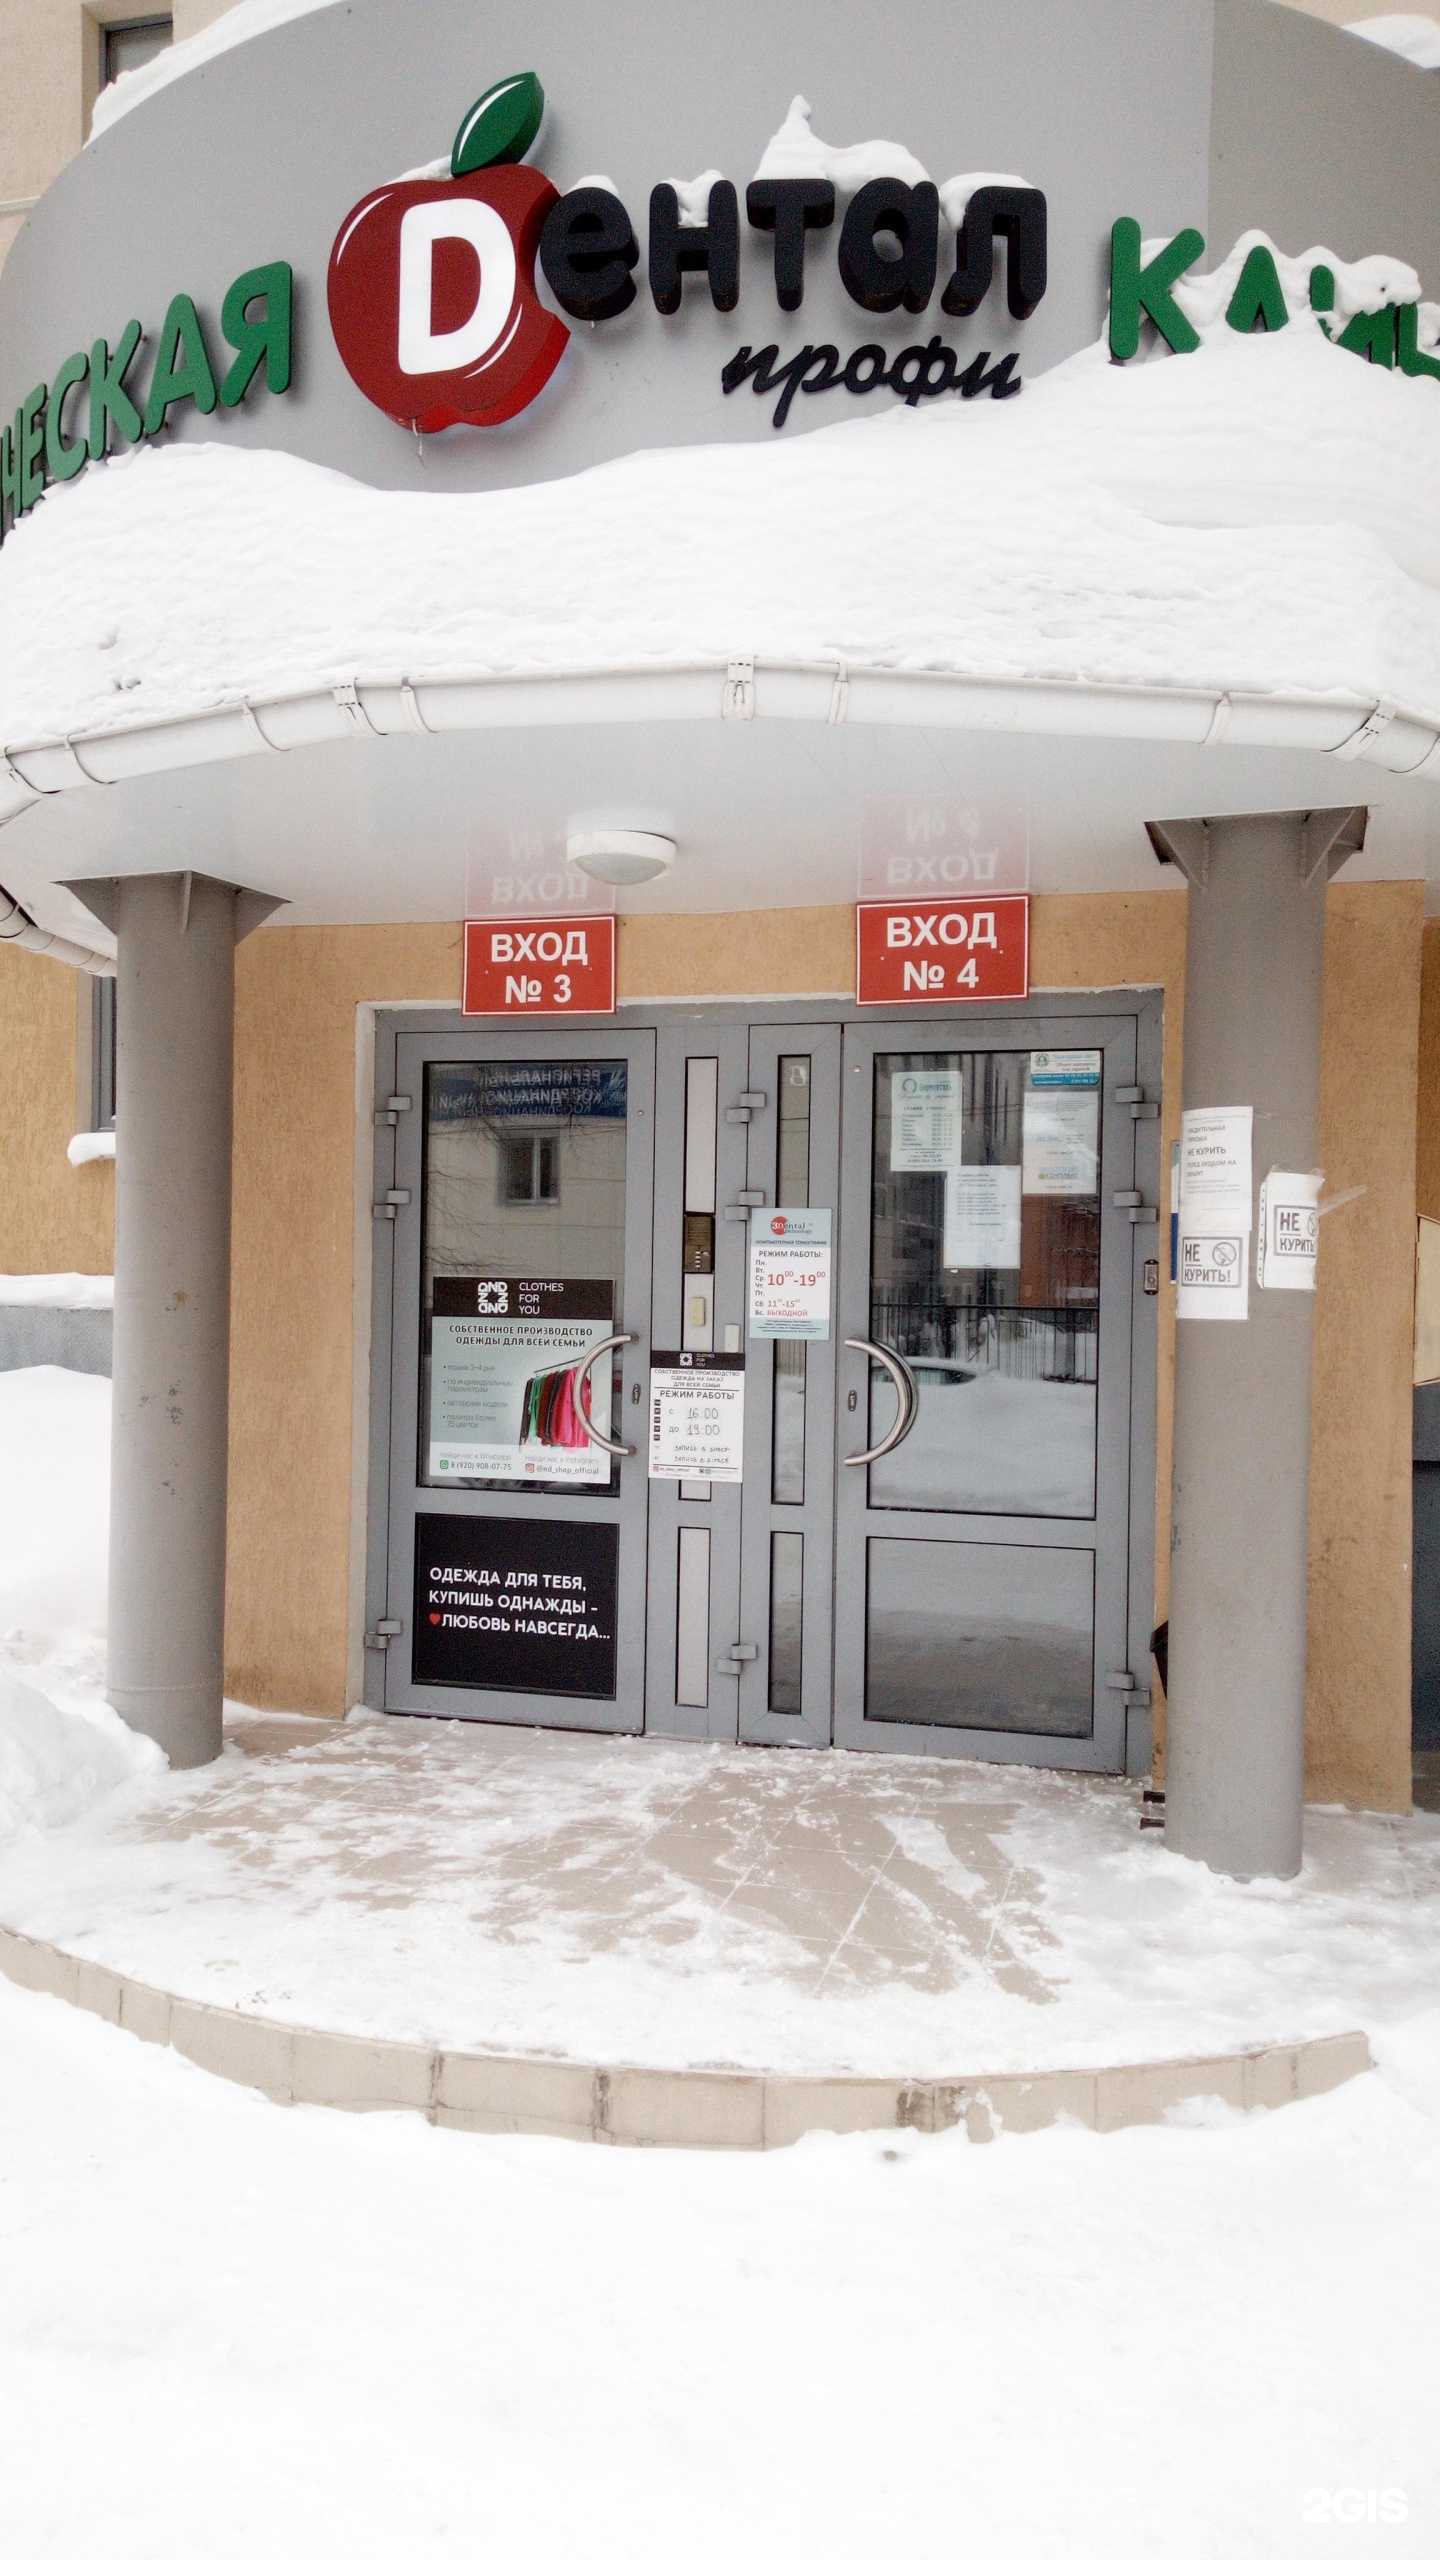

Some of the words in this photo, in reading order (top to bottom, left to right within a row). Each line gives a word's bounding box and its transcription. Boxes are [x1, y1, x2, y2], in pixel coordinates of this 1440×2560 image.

[721, 335, 1023, 428] профи
[885, 911, 997, 951] ВХОД
[490, 931, 589, 966] ВХОД
[903, 960, 946, 991] №
[957, 957, 980, 990] 4
[504, 975, 543, 1004] №
[553, 974, 573, 1003] 3
[1196, 1146, 1227, 1156] КУРИТЬ
[1280, 1211, 1301, 1232] НЕ
[758, 1250, 788, 1258] РЕЖИМ
[1184, 1243, 1201, 1262] НЕ
[1184, 1268, 1232, 1283] КУРИТЬ!
[519, 1282, 564, 1292] CLOTHES
[519, 1294, 540, 1303] FOR
[519, 1305, 540, 1315] YOU
[450, 1324, 514, 1335] СОБСТВЕННОЕ
[517, 1326, 593, 1337] ПРОИЗВОДСТВО
[455, 1336, 500, 1346] ОДЕЖДЫ
[503, 1338, 524, 1346] ДЛЯ
[526, 1337, 550, 1347] ВСЕЙ
[552, 1339, 585, 1348] СЕМЬИ
[660, 1390, 694, 1399] РЕЖИМ
[696, 1392, 735, 1400] РАБОТЫ
[430, 1567, 500, 1586] ОДЕЖДА
[505, 1572, 538, 1588] ДЛЯ
[543, 1574, 587, 1592] ТЕБЯ,
[429, 1590, 494, 1608] КУПИШЬ
[497, 1594, 586, 1615] ОДНАЖДЫ
[442, 1613, 511, 1632] ЛЮБОВЬ
[515, 1618, 611, 1641] НАВСЕГДА...
